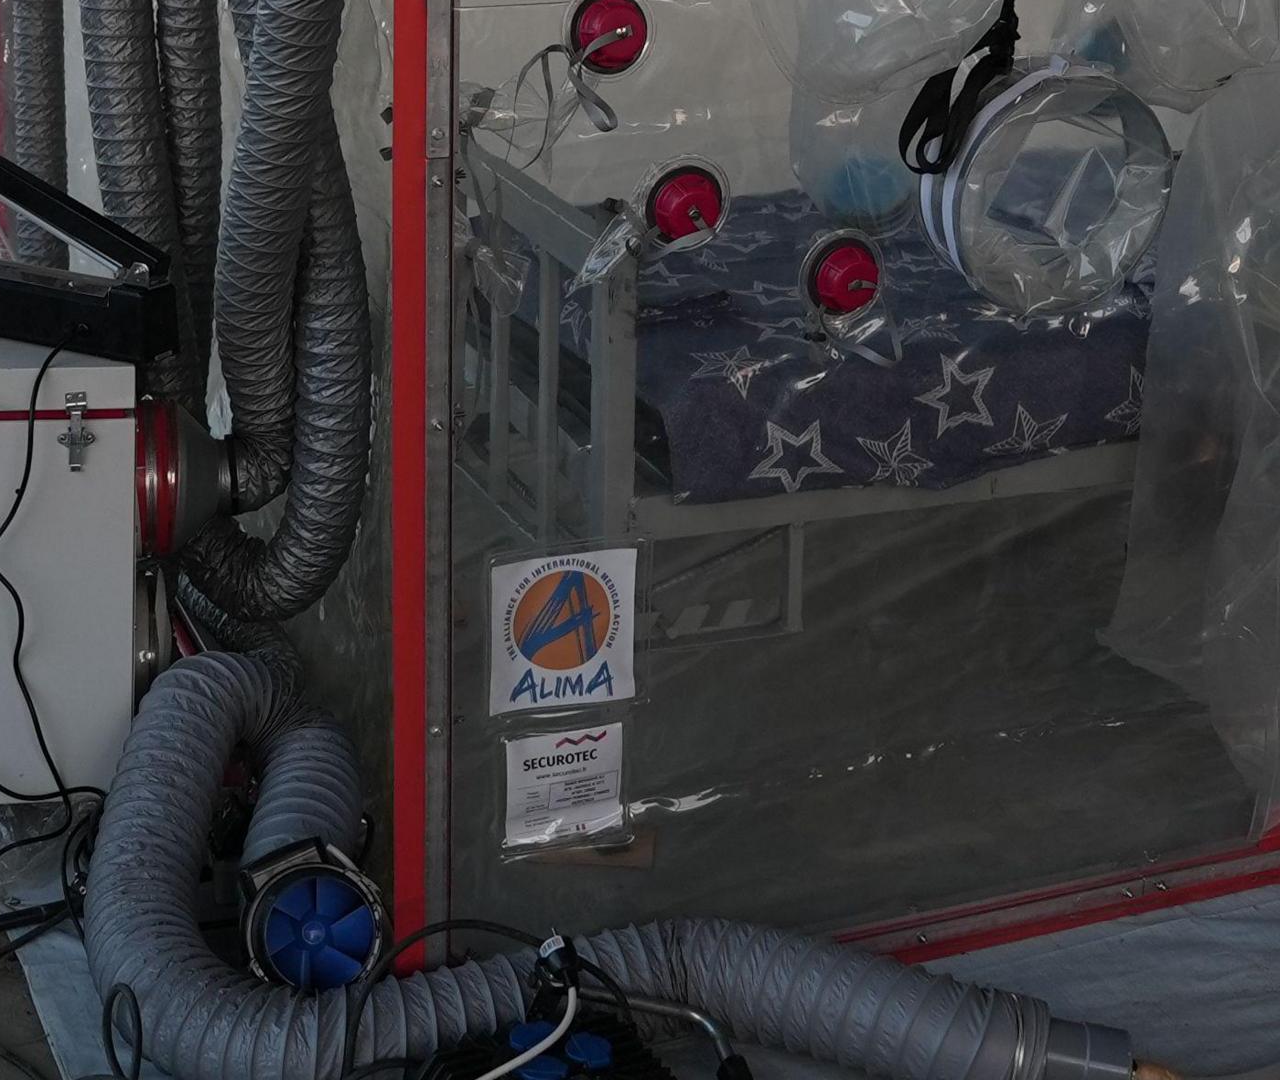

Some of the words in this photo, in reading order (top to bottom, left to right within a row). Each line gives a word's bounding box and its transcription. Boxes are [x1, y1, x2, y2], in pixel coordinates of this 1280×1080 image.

[531, 558, 601, 578] INTERNATIONAL
[515, 576, 531, 595] FOR
[601, 572, 621, 610] MEDICAL
[504, 597, 516, 643] ALLIANCE
[606, 614, 621, 649] ACTION
[505, 645, 518, 661] THE
[510, 660, 614, 703] ALIMA
[523, 748, 598, 772] SECUROTEC
